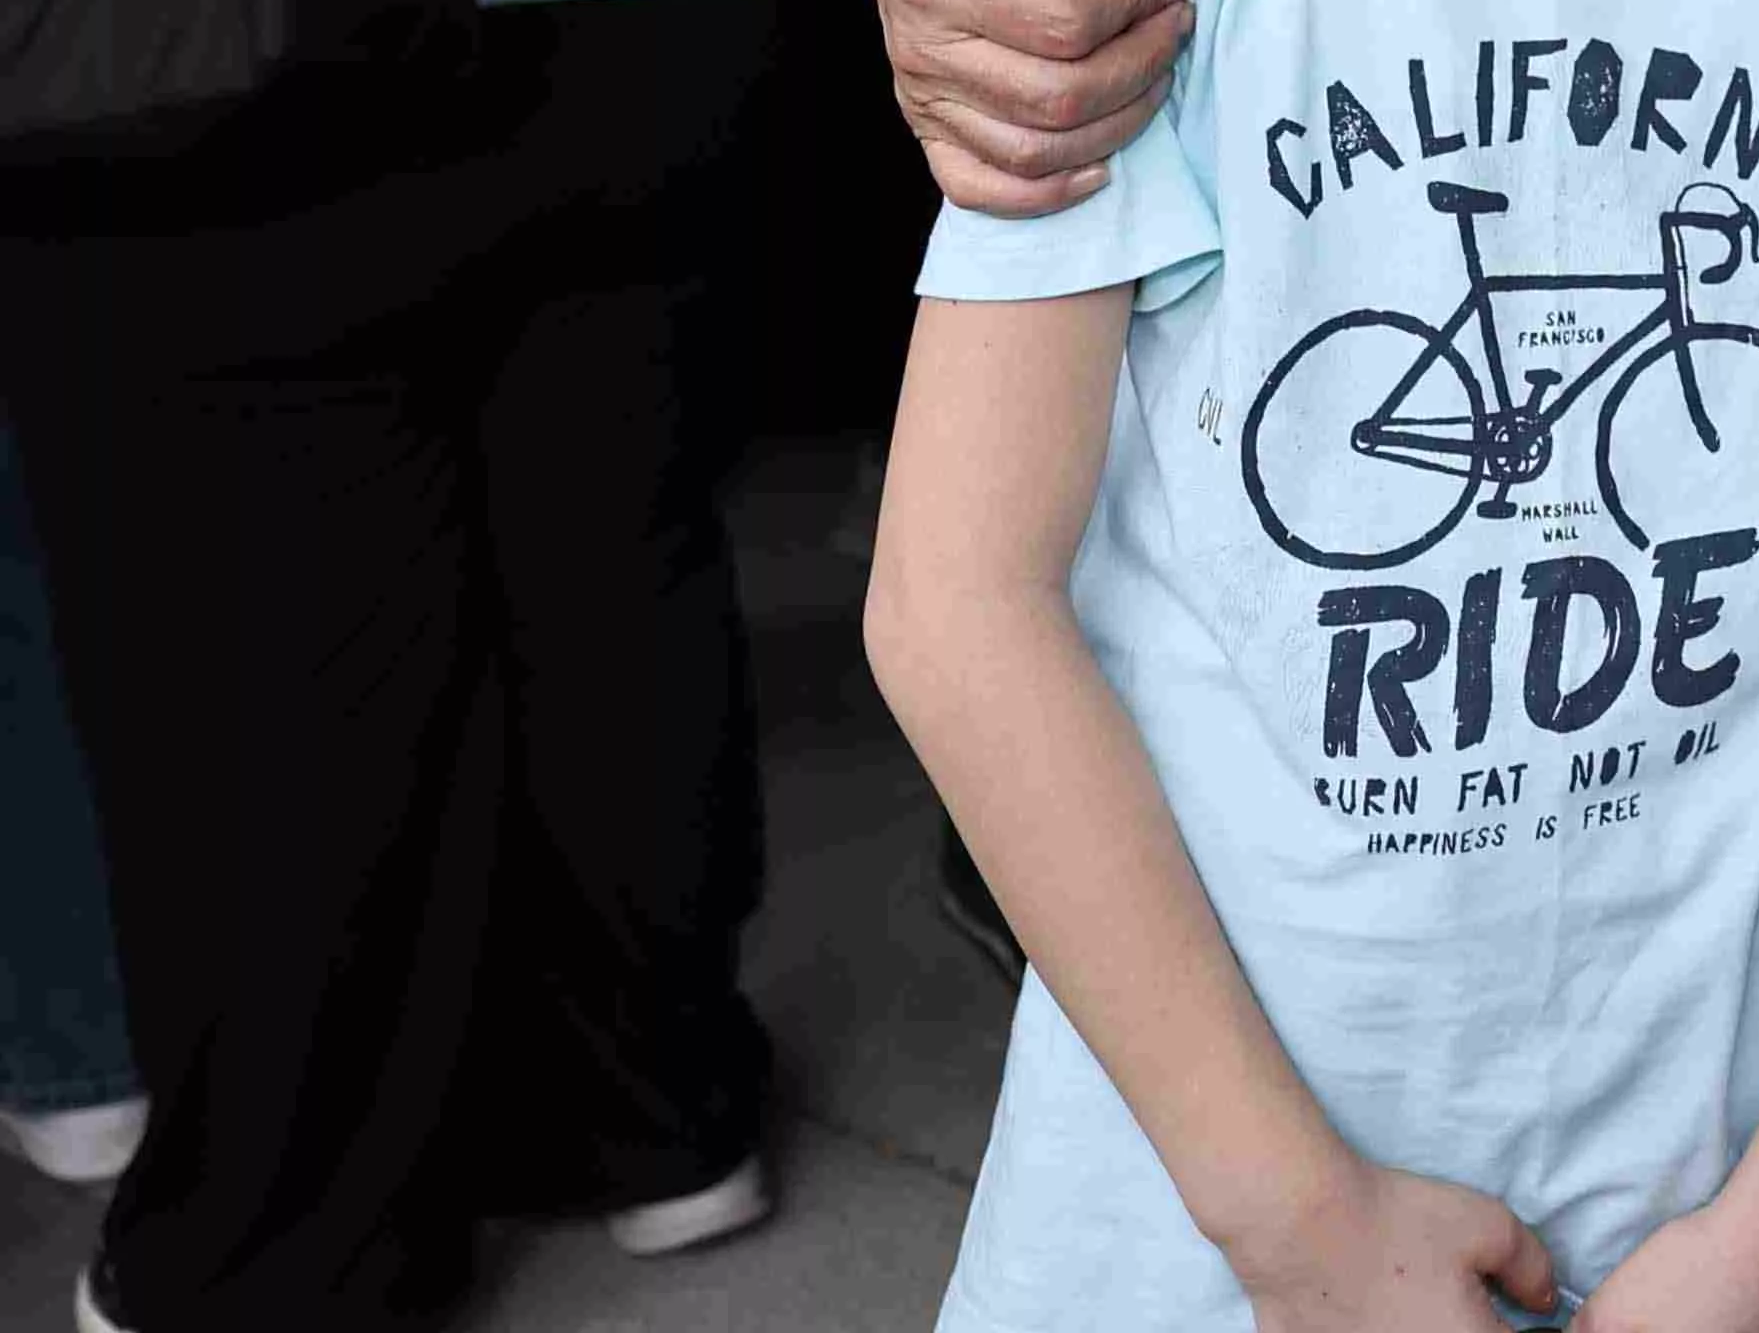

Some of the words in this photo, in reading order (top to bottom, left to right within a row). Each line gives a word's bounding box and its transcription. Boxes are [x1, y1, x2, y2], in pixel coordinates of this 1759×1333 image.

[1546, 310, 1576, 327] SAN
[1518, 327, 1605, 348] FRANCISCO
[1521, 500, 1598, 522] MARSHALL
[1543, 525, 1580, 543] WALL
[1313, 775, 1418, 817] BURN
[1457, 763, 1529, 813] FAT
[1568, 740, 1648, 794] NOT
[1673, 720, 1720, 766] OIL
[1367, 823, 1507, 856] HAPPINESS
[1535, 815, 1558, 841] IS
[1583, 792, 1642, 831] FREE
